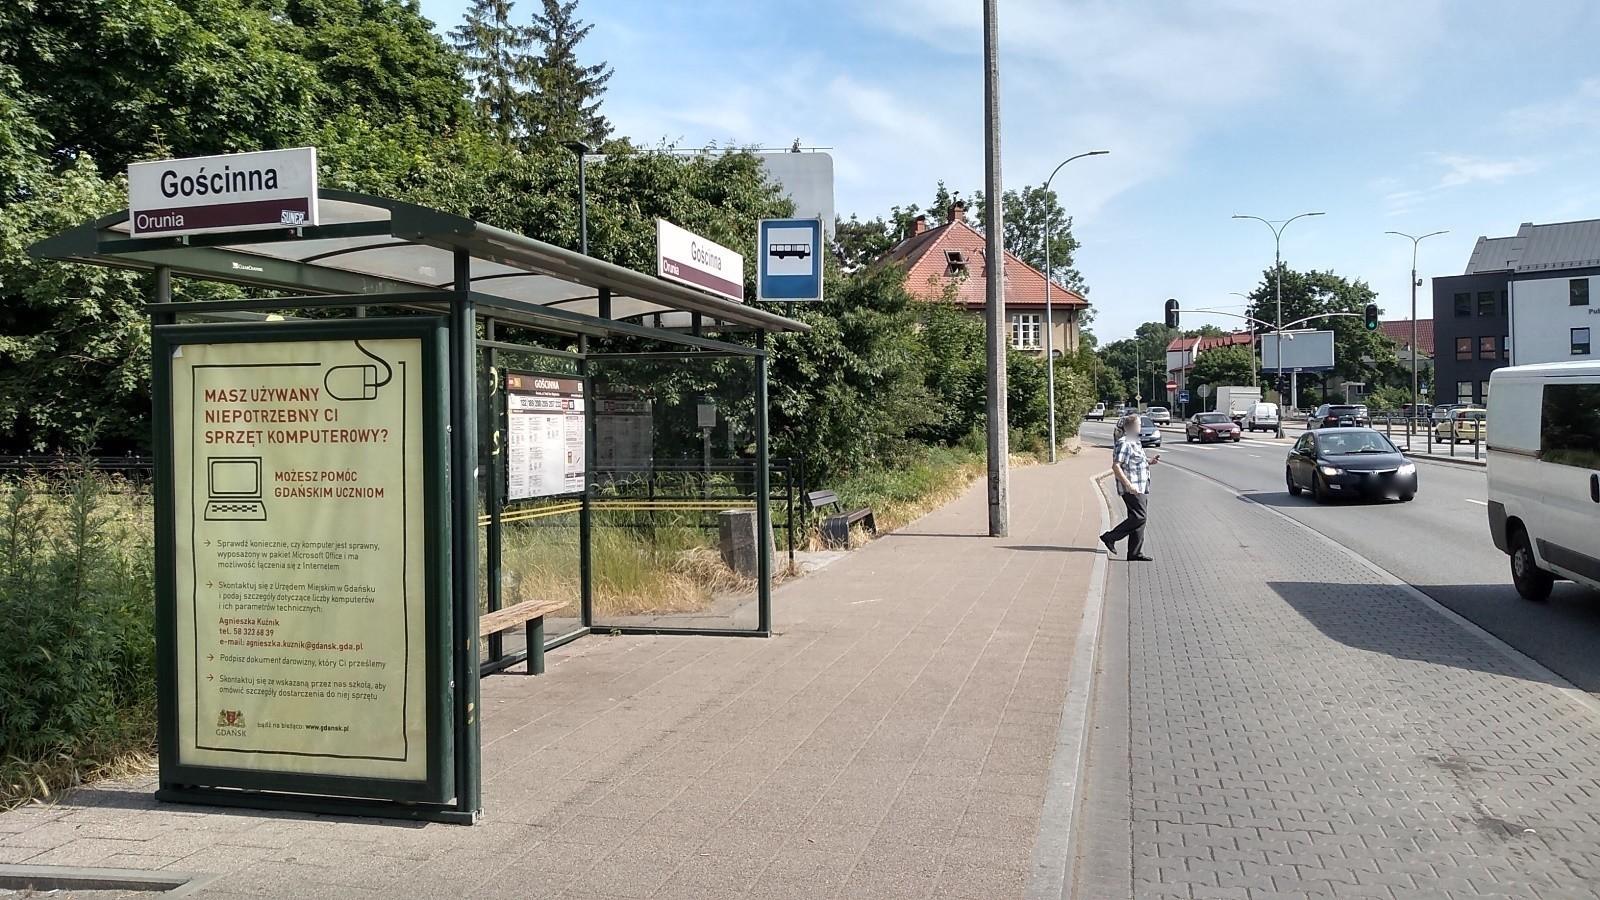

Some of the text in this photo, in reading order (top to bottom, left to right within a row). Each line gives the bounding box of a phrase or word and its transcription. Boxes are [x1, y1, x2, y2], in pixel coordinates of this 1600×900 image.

[160, 165, 279, 199] Gościnna
[136, 212, 185, 230] Orunia
[691, 241, 722, 270] Gościnna
[663, 258, 680, 276] Orunia
[204, 385, 319, 403] MASZ UŻYWANY
[205, 408, 339, 423] NIEPOTRZEBNY CI
[205, 428, 388, 448] SPRZĘT KOMPUTEROWY?
[274, 468, 357, 482] MOŻESZ POMÓC
[274, 484, 384, 498] GDAŃSKIM UCZNIOM
[217, 540, 248, 548] Sprawdź
[250, 540, 289, 548] koniecznie,
[302, 542, 334, 550] komputer
[334, 542, 347, 550] jest
[218, 551, 260, 559] wyposażony
[269, 551, 290, 559] pakiet
[292, 552, 324, 560] Microsoft
[303, 562, 340, 570] Internetem
[218, 581, 256, 590] Skontaktuj
[258, 582, 268, 591] się
[274, 582, 306, 592] Urzędem
[307, 584, 336, 592] Miejskim
[344, 584, 376, 593] Gdańsku
[222, 592, 242, 600] podaj
[244, 593, 276, 602] szczegóły
[276, 594, 310, 602] dotyczące
[312, 594, 330, 604] liczby
[331, 595, 375, 604] komputerów
[219, 617, 280, 626] Agnieszka Kuźnik
[220, 654, 386, 670] Podpisz dokument darowizny, który Ci prześlemy
[220, 674, 255, 685] Skontaktuj
[256, 676, 266, 686] się
[276, 678, 309, 688] wskazaną
[311, 680, 332, 688] przez
[374, 682, 386, 691] aby
[220, 686, 244, 694] omówić
[246, 688, 277, 698] szczegóły
[278, 688, 324, 698] dostarczenia
[337, 692, 350, 700] niej
[352, 692, 378, 701] sprzętu
[216, 728, 247, 736] GDAŃSK
